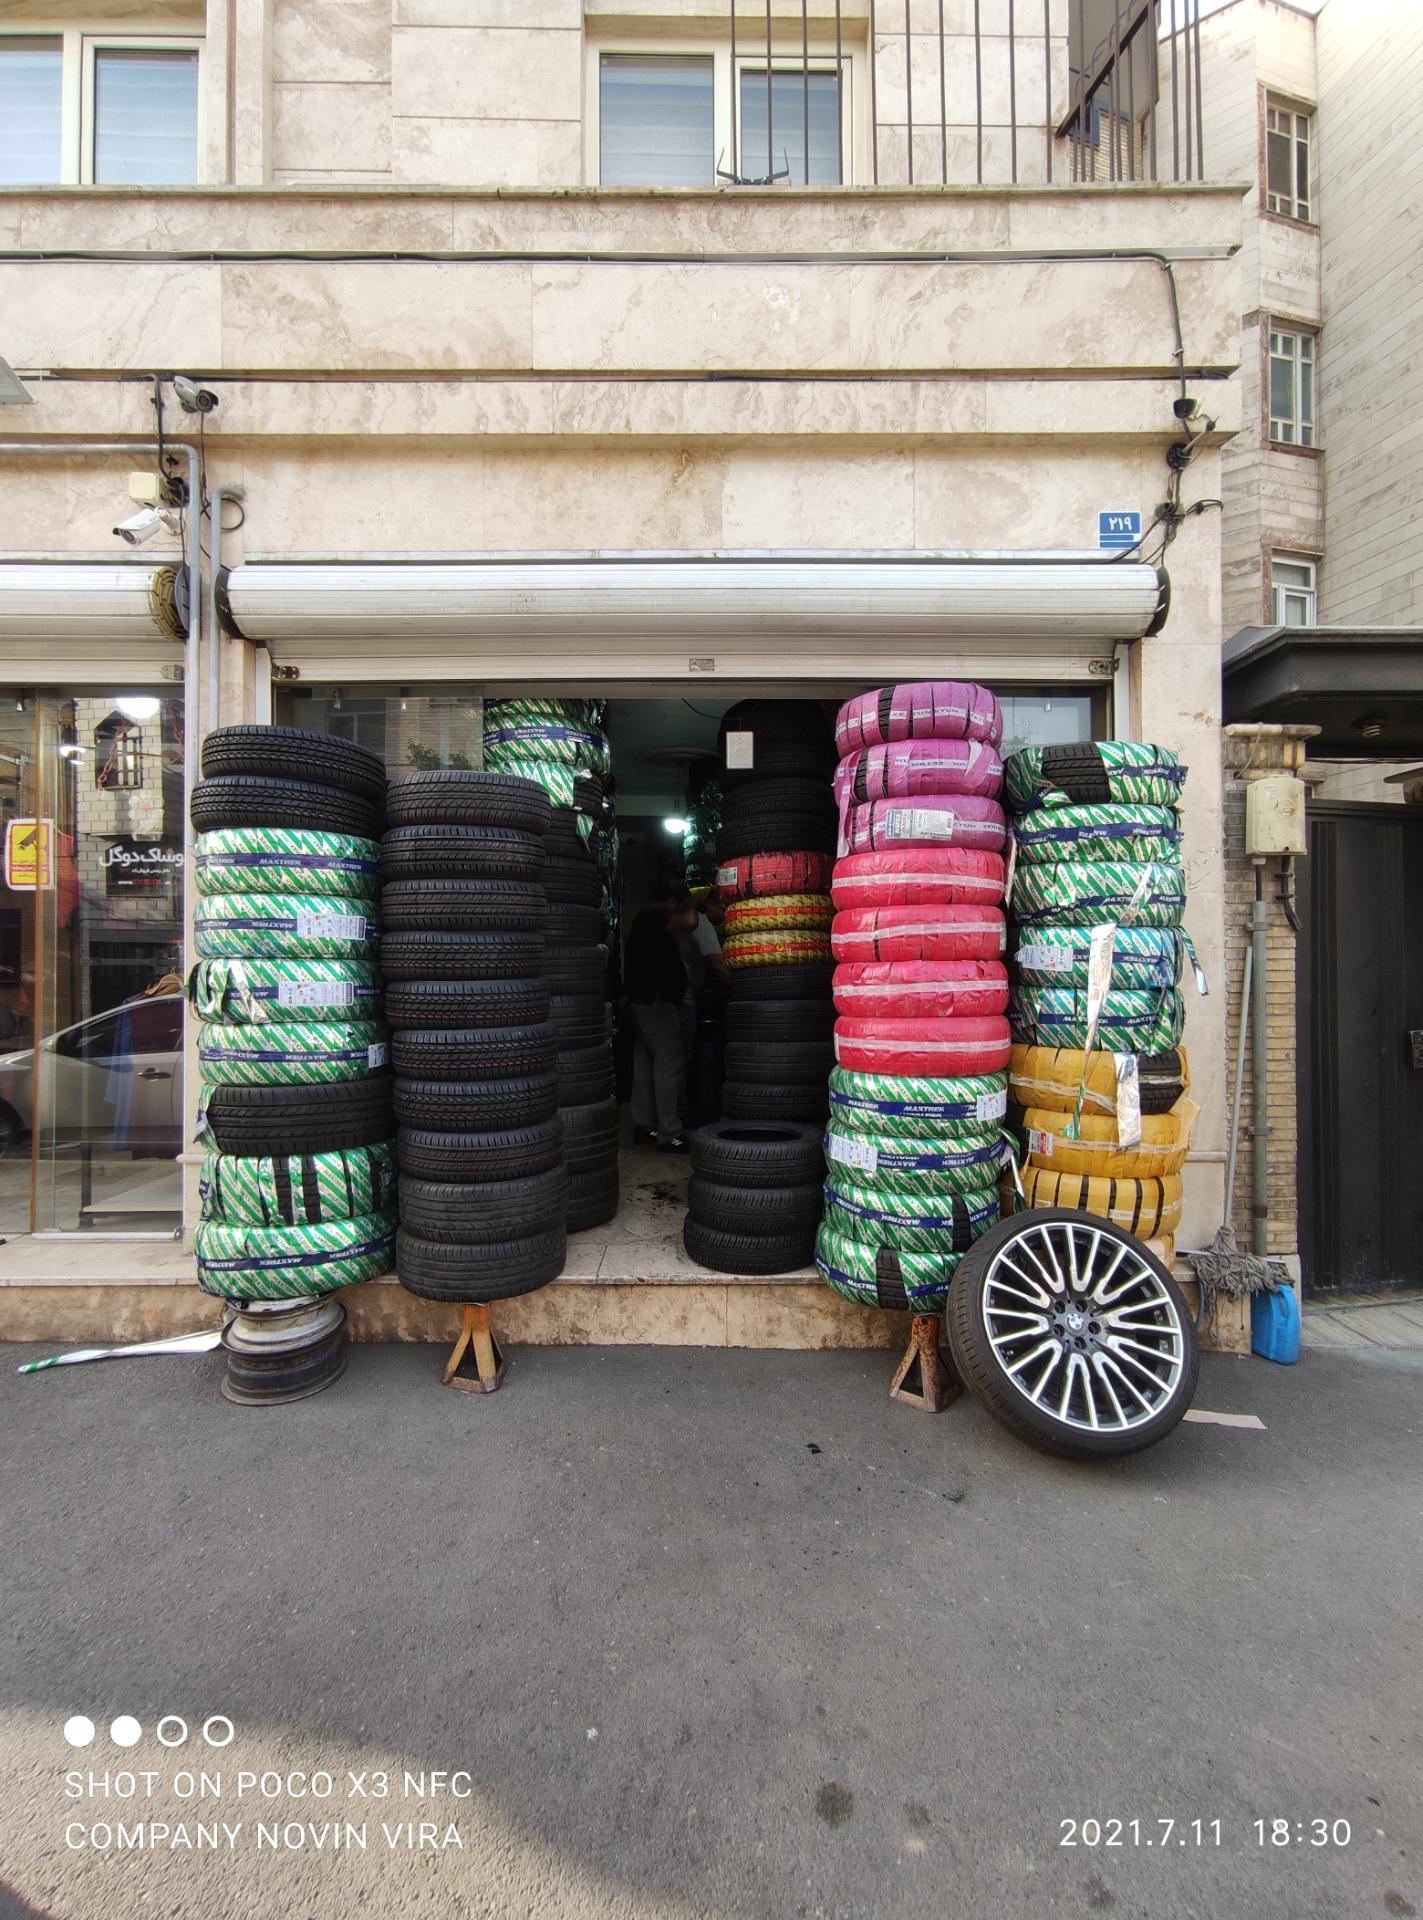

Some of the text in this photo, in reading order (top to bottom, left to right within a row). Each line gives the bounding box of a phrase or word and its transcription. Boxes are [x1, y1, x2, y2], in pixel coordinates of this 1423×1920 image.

[1108, 516, 1133, 531] ۲۱۹
[98, 845, 185, 867] وشاک دوگل
[258, 858, 302, 866] MAXTREK
[326, 861, 362, 871] MAXTREK
[251, 920, 295, 929] MAXTREK
[1121, 956, 1158, 964] MAXTREK
[285, 1053, 329, 1061] MAXTREK
[847, 1099, 880, 1110] MAXTREK
[877, 1158, 918, 1168] MAXTREK
[880, 1213, 921, 1226] MAXTREK
[258, 1257, 303, 1266] MAXTREK
[846, 1278, 877, 1293] MAXTRE
